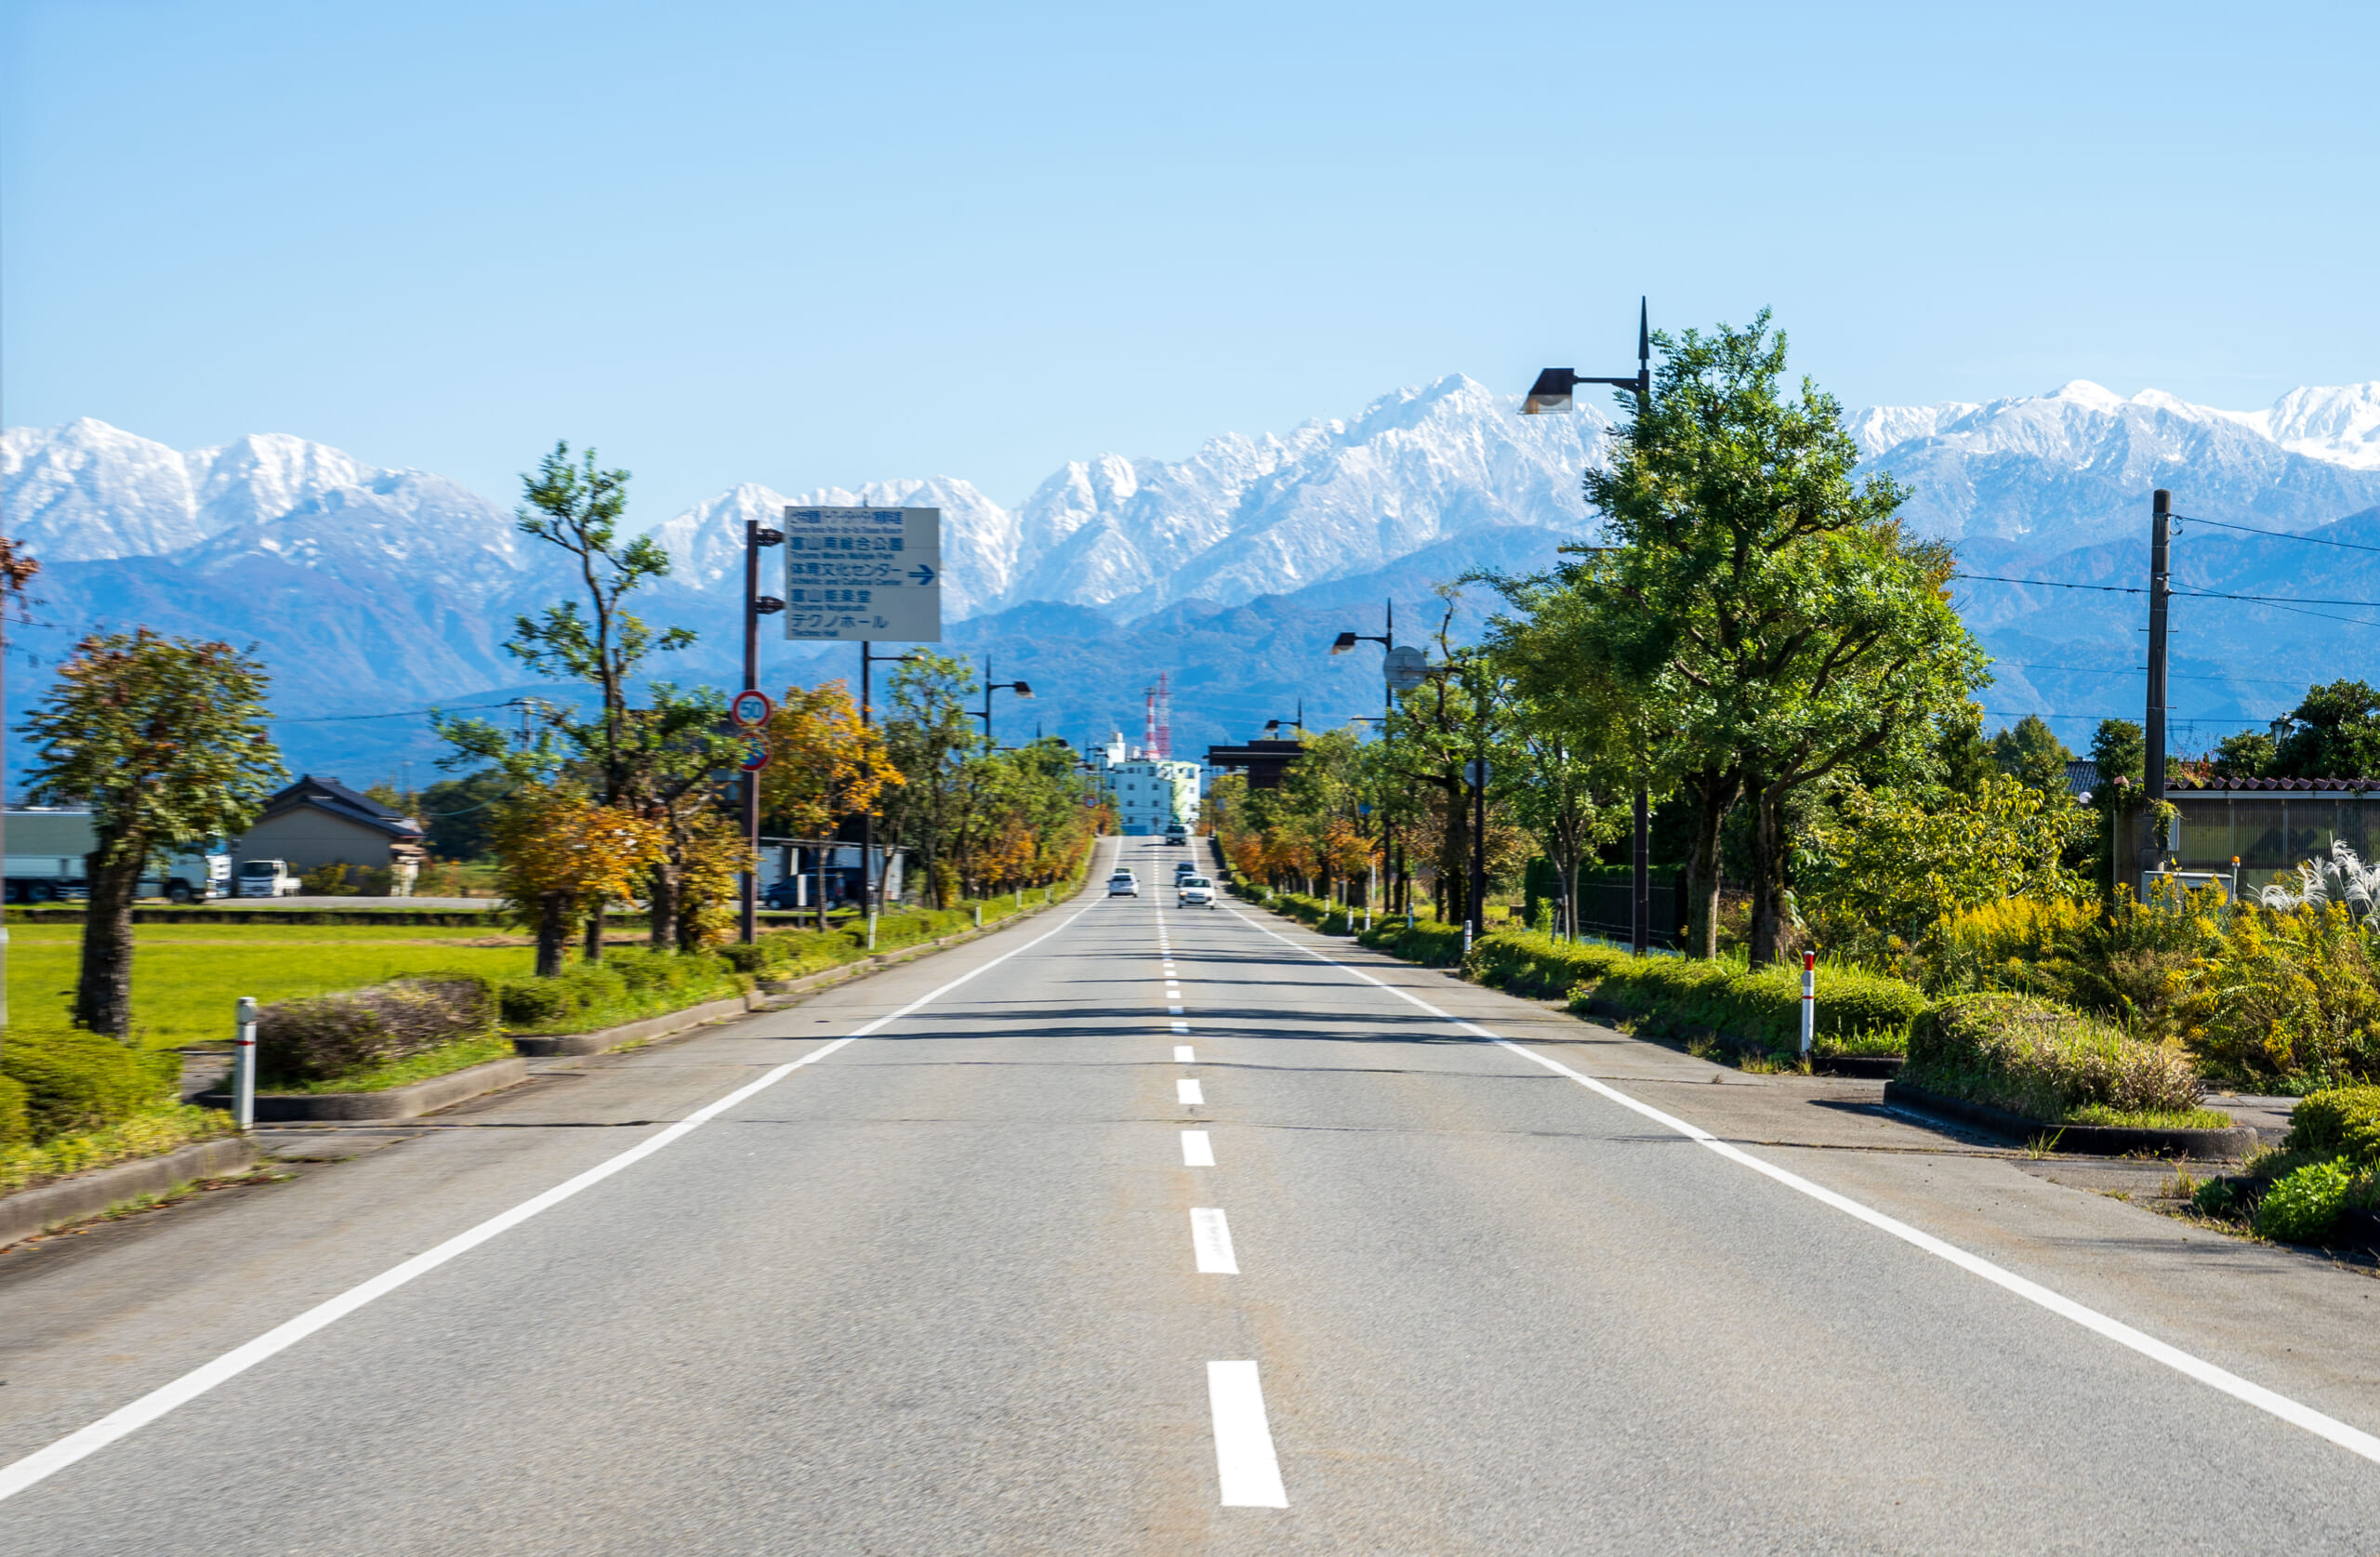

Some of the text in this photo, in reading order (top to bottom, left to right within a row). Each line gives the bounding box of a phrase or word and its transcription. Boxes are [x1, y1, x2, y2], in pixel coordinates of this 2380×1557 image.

[790, 551, 819, 561] Toyama
[791, 562, 903, 576] 体育文化センター
[791, 603, 823, 612] Toyama
[792, 614, 890, 628] テクノホール
[741, 701, 762, 718] 50
